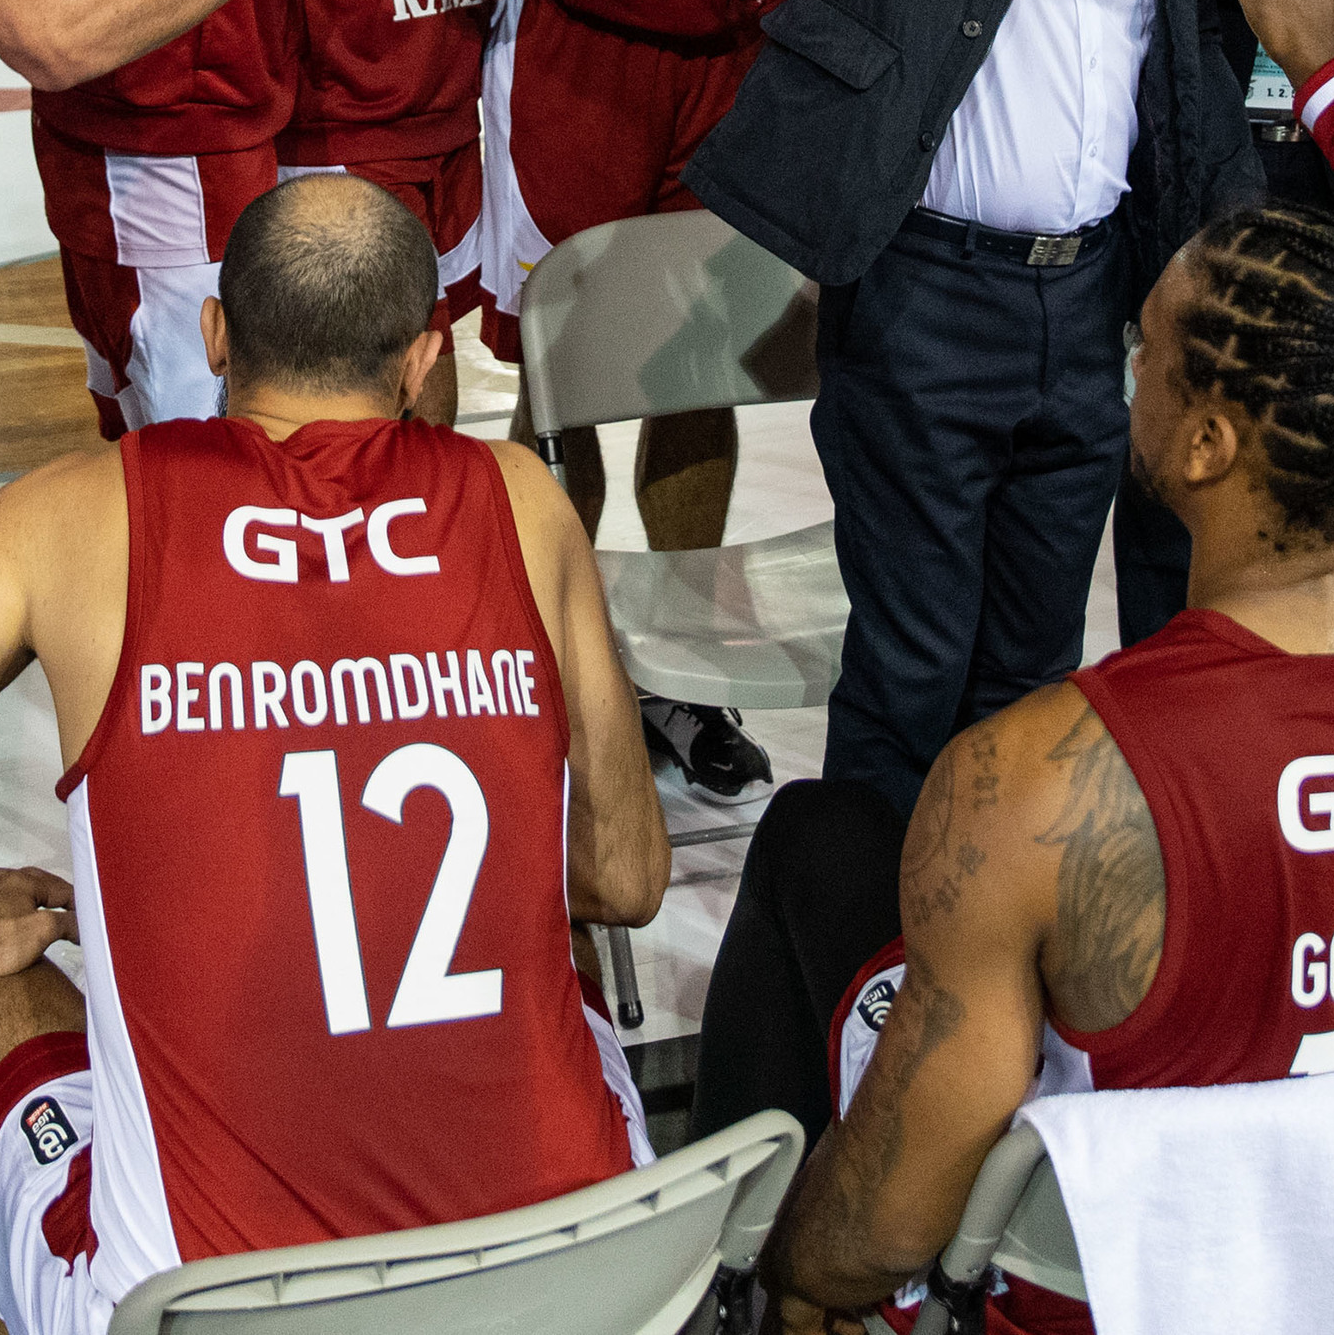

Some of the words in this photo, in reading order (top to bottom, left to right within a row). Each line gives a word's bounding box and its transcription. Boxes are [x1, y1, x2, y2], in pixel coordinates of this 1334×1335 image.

[223, 498, 441, 584] GTC
[141, 649, 541, 735] BENROMDHANE
[278, 742, 504, 1036] 12
